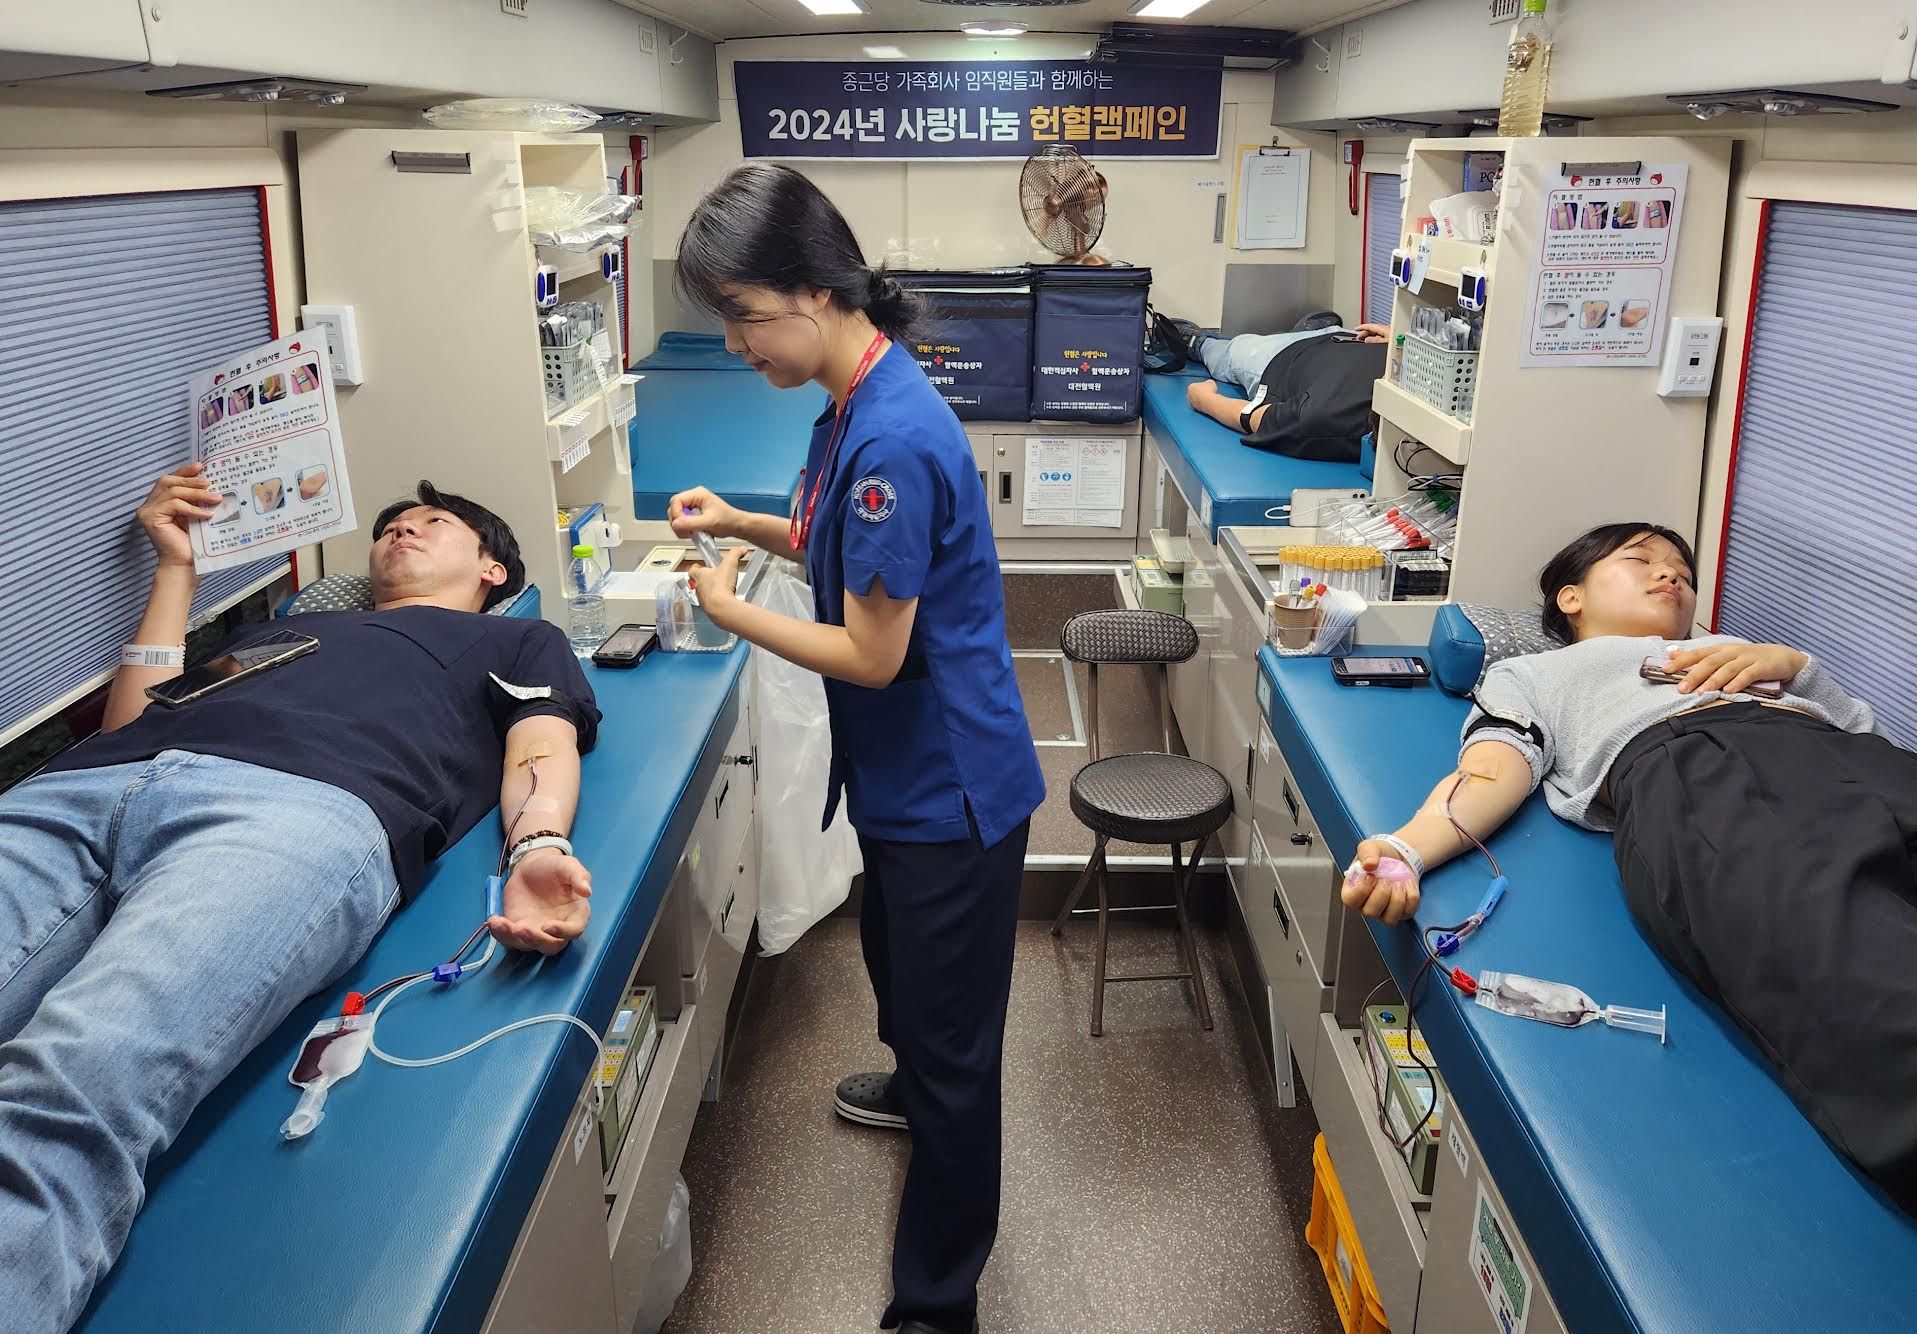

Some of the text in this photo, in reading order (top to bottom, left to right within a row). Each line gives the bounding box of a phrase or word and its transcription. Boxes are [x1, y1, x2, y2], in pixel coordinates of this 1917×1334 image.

[842, 68, 1114, 92] 종근당 가족회사 임직원들과 함께하는
[768, 104, 1187, 143] 2024년 사랑나눔 헌혈캠페인
[1605, 177, 1611, 186] 후
[1615, 176, 1642, 186] 주의사항
[934, 345, 960, 354] 사랑입니다
[1063, 350, 1108, 359] 헌혈은 사랑입니다
[255, 352, 281, 367] 주의사항
[945, 361, 983, 370] 혈액운송상자
[1041, 366, 1130, 376] 대한적십자사 혈액운송상자
[1068, 382, 1101, 391] 대전혈액원
